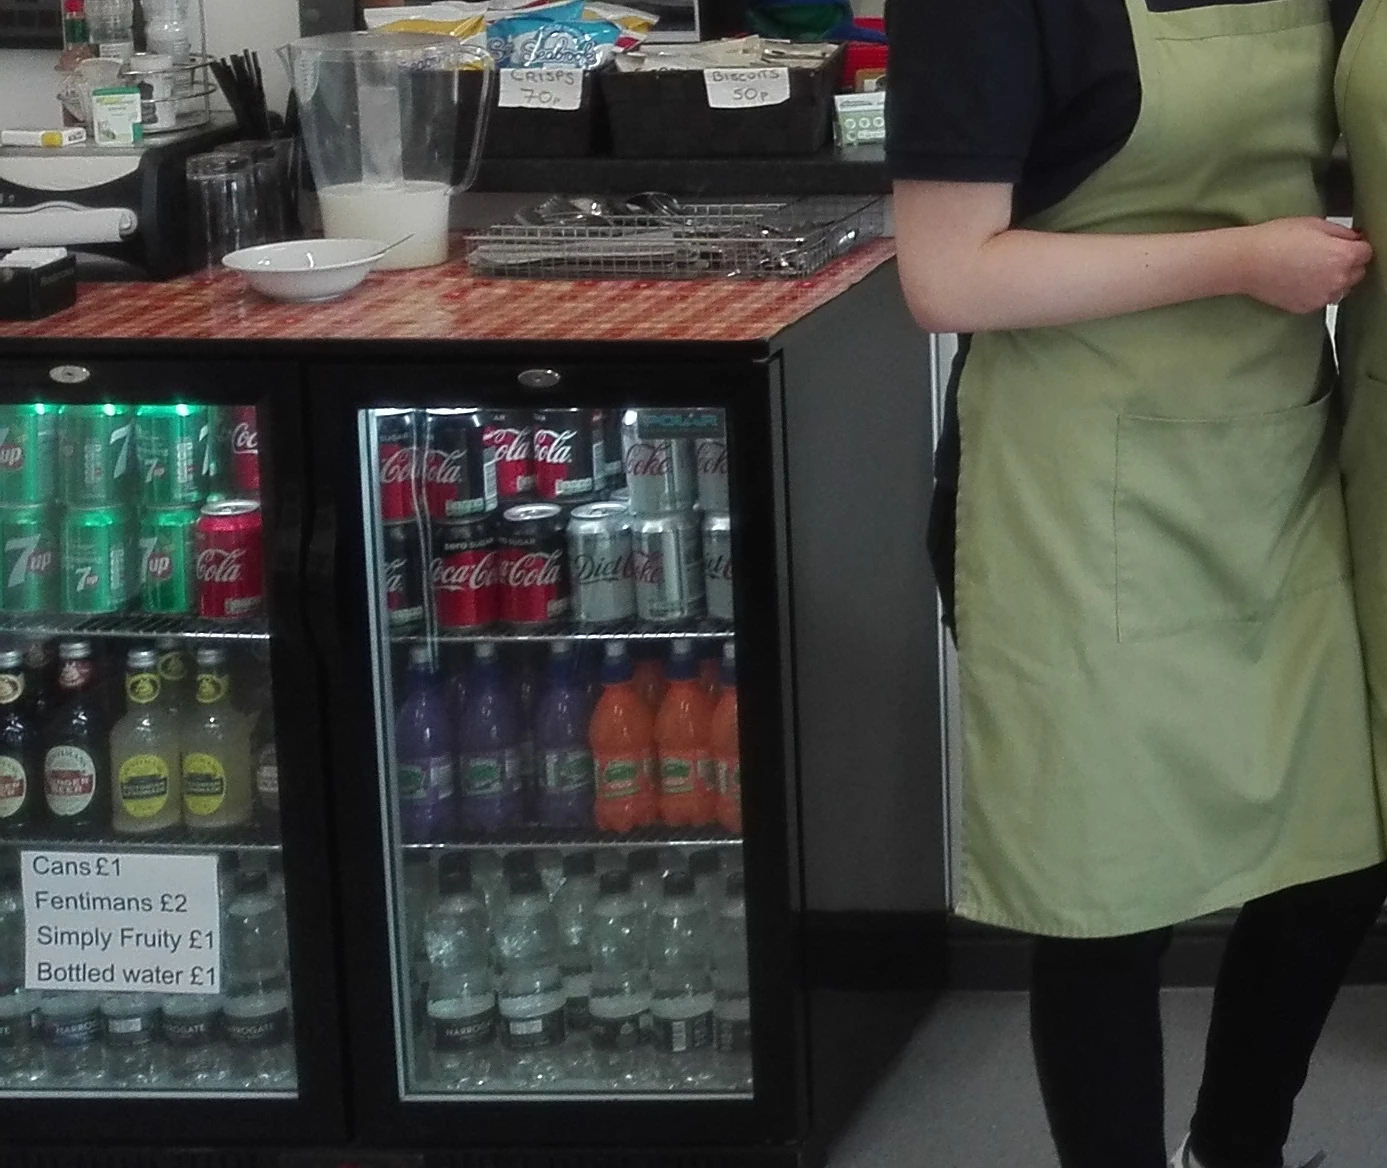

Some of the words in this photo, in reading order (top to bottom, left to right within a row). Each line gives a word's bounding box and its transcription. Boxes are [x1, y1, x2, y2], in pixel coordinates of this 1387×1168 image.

[510, 69, 575, 85] CRISPS
[33, 856, 92, 877] Cans
[96, 857, 121, 877] £1
[35, 892, 153, 913] Fentimans
[160, 895, 187, 914] £2
[37, 926, 113, 952] Simply
[120, 928, 182, 953] Fruity
[189, 930, 215, 949] £1
[37, 962, 115, 984] Bottled
[123, 965, 184, 986] water
[190, 967, 216, 987] £1
